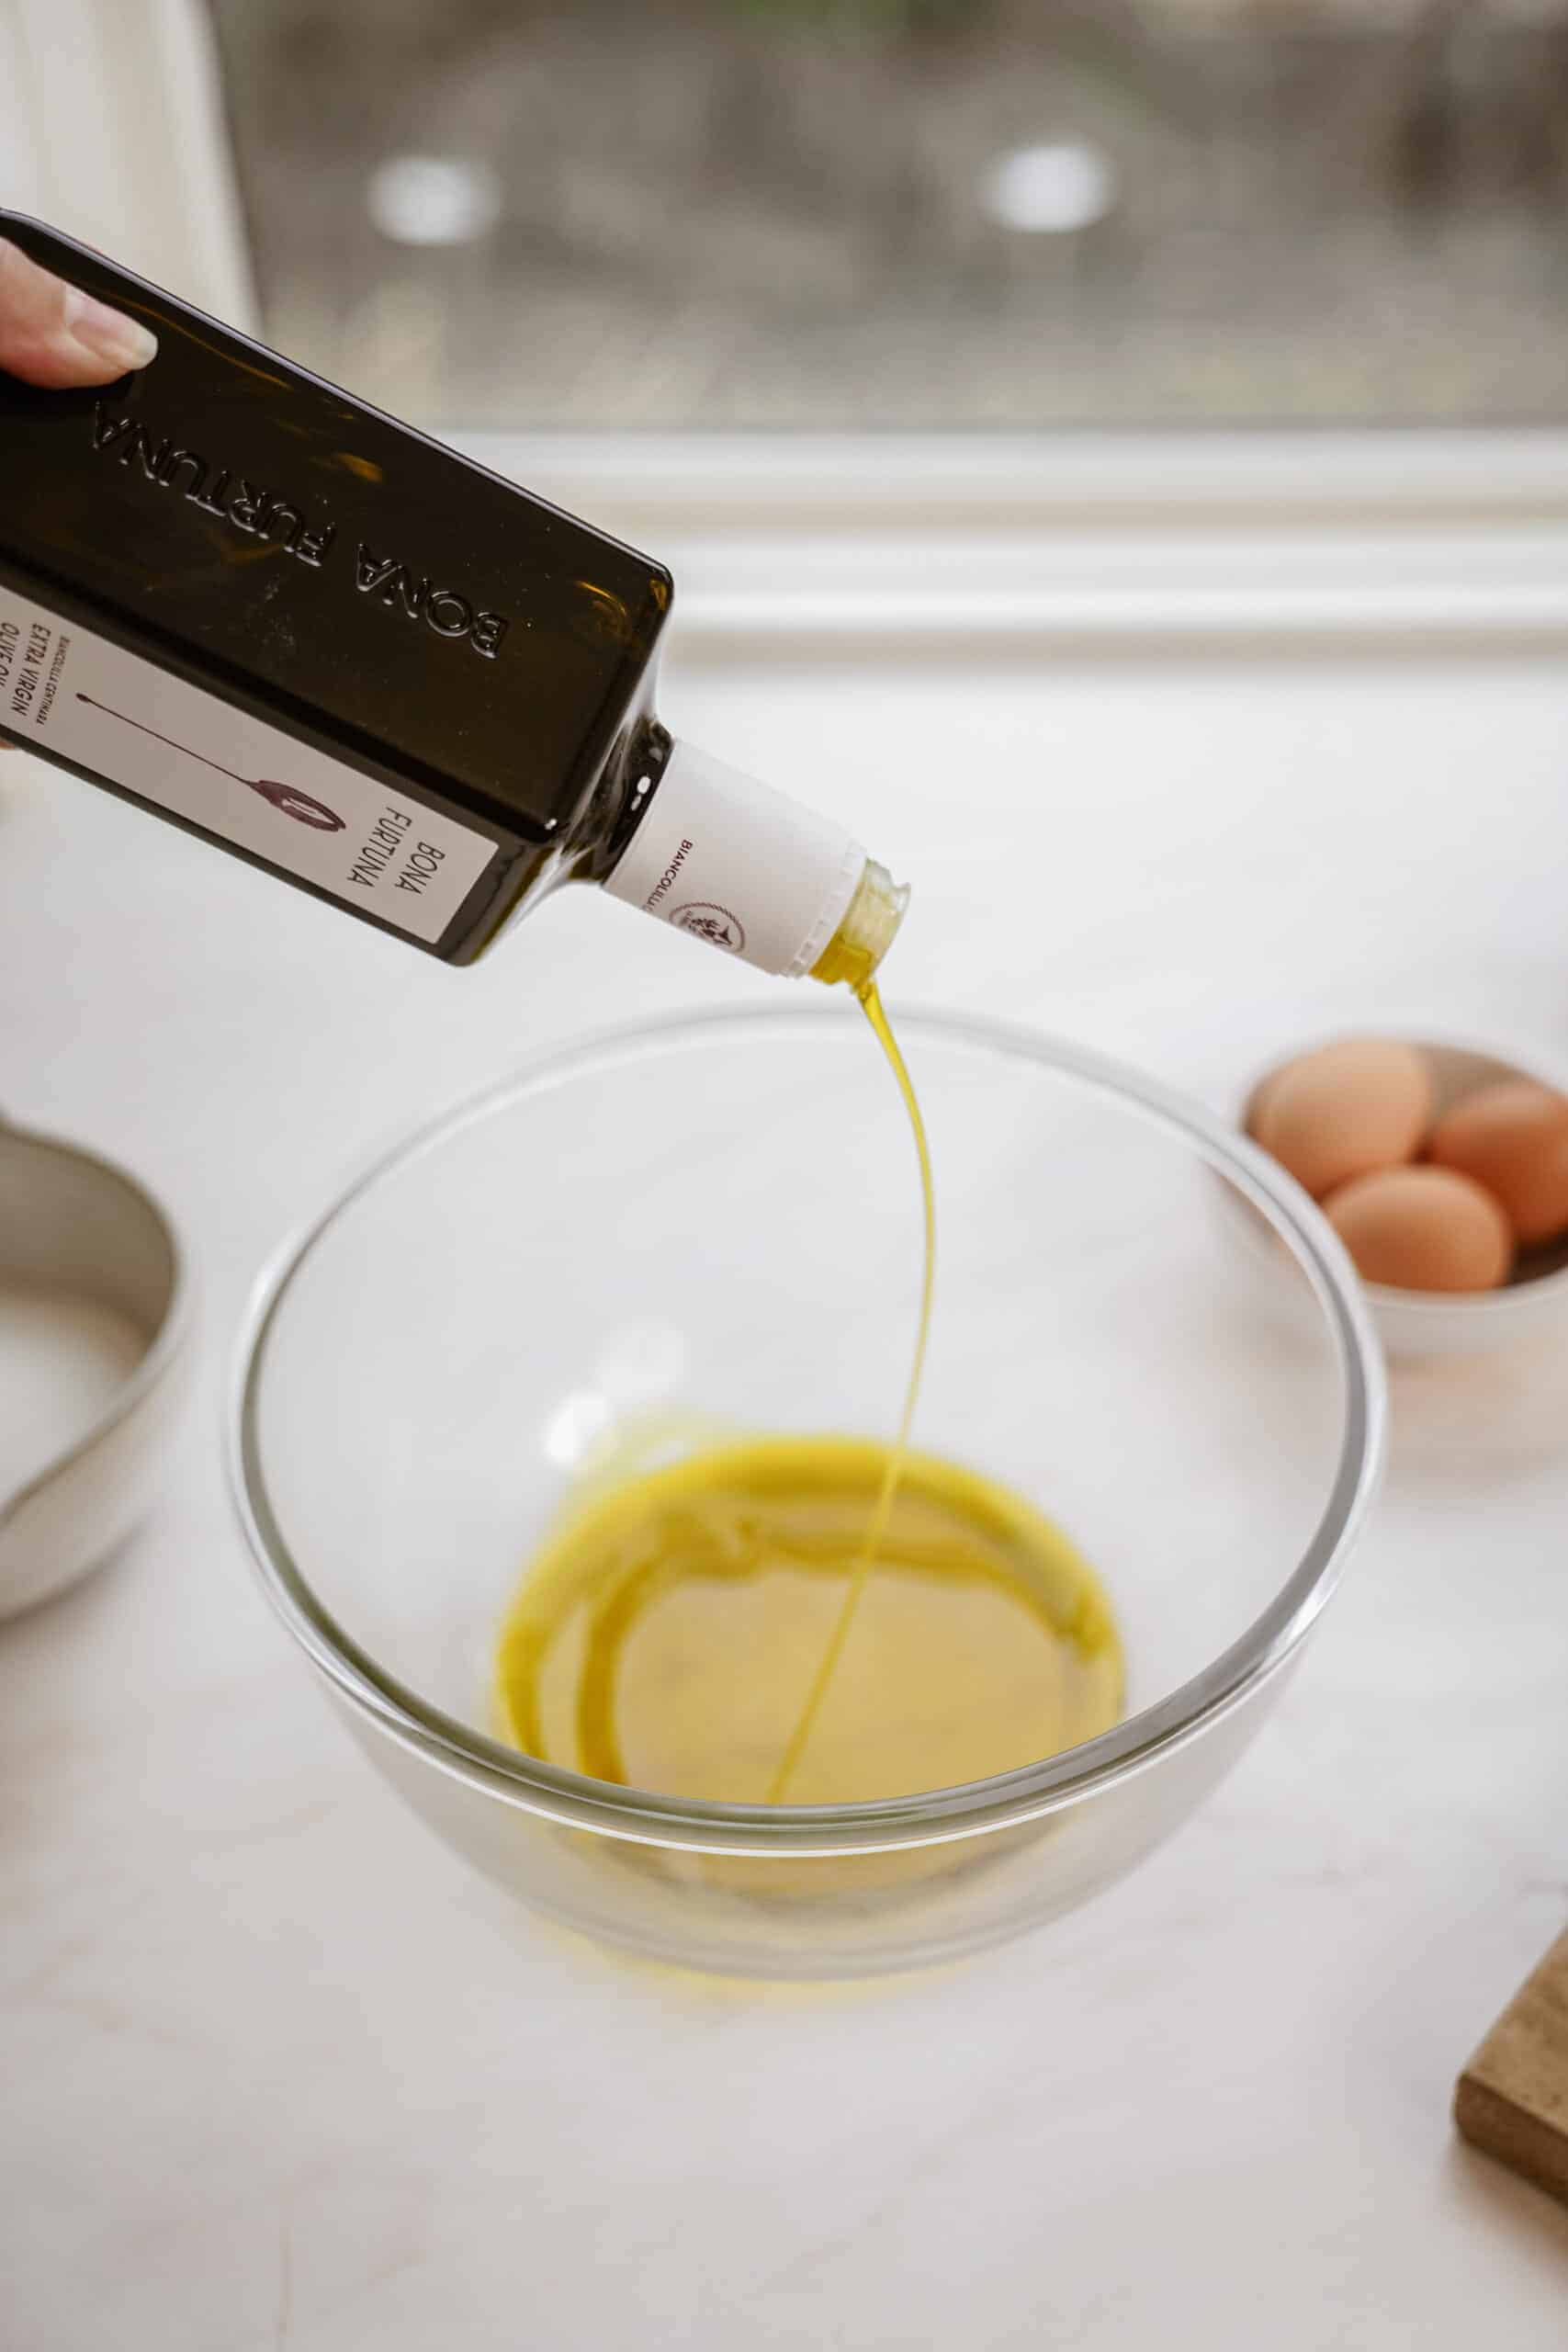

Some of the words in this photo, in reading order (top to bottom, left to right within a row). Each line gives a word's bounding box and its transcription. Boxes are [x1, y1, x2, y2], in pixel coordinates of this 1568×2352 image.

[91, 400, 337, 567] FURTUNA
[355, 543, 508, 659] BONA
[24, 623, 51, 665] EXTRA
[11, 667, 39, 717] VIRGIN
[346, 807, 412, 888] FURTUNA
[394, 841, 446, 895] BONA
